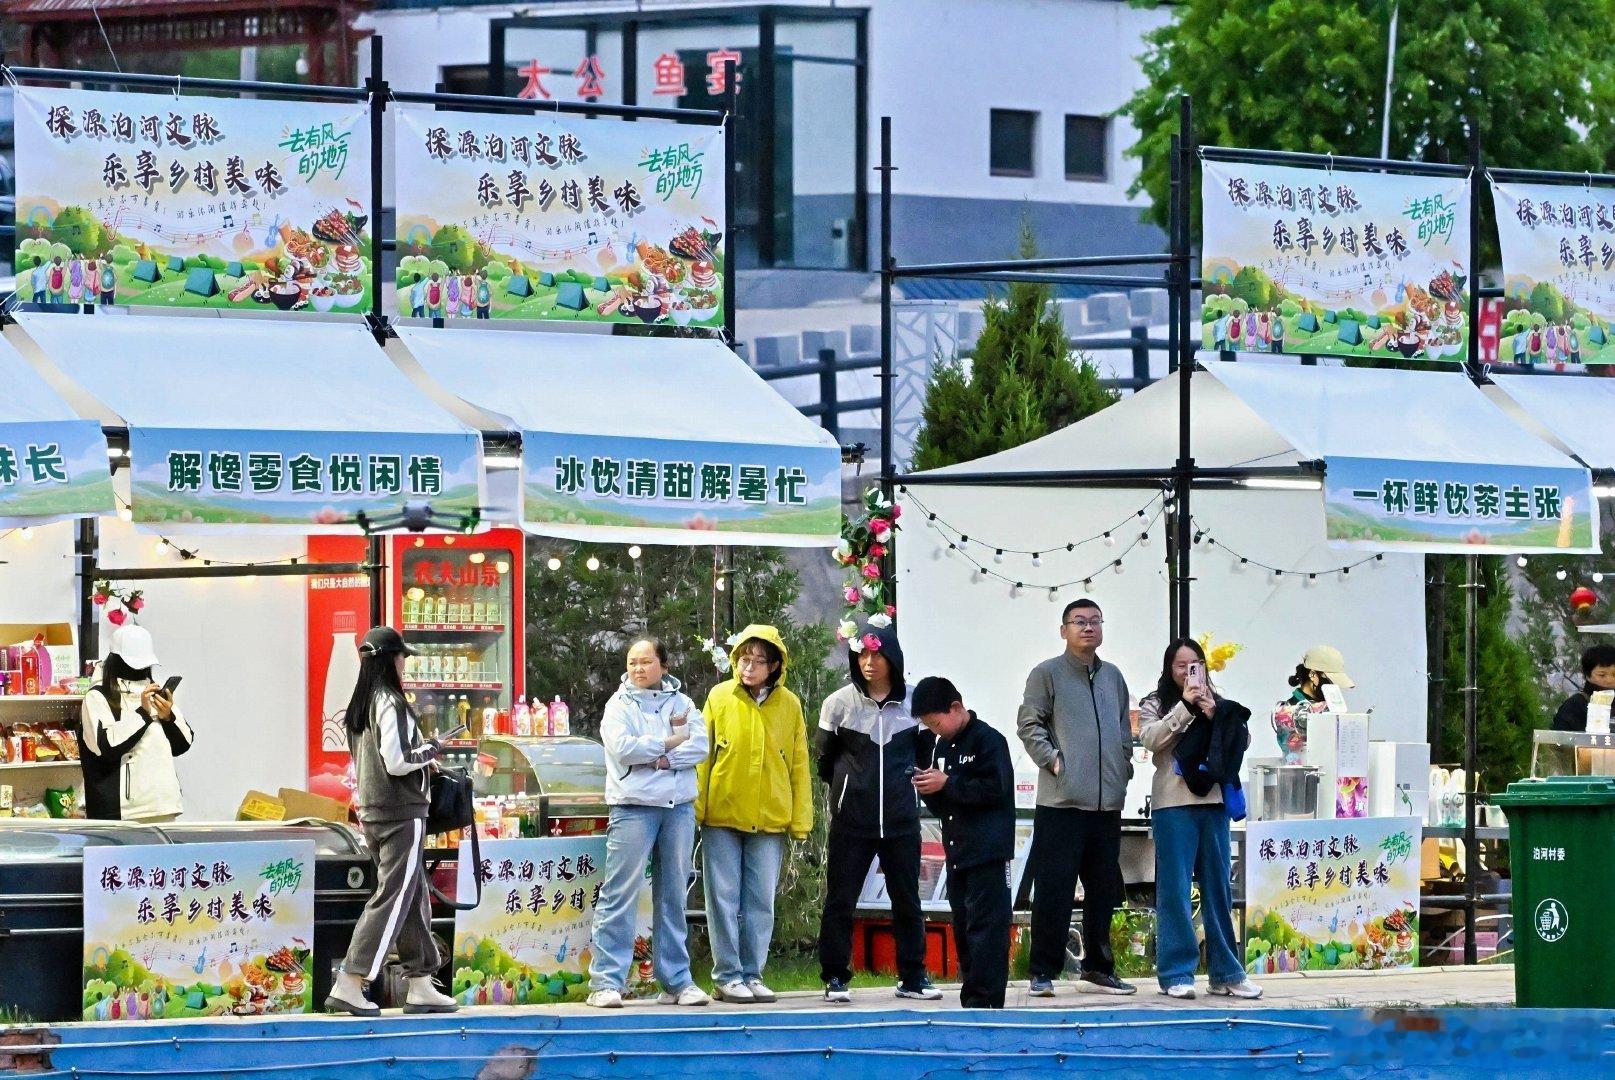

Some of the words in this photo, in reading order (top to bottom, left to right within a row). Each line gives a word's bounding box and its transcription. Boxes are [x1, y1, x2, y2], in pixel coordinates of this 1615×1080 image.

[46, 105, 221, 144] 探源泊河文脉
[426, 127, 584, 165] 探源泊河文脉
[103, 150, 285, 194] 乐享乡村美味
[477, 170, 642, 214] 乐享乡村美味
[1227, 178, 1358, 213] 探源泊河文脉
[1516, 198, 1615, 230] 探源泊河文
[1272, 217, 1408, 260] 乐享乡村美味
[168, 451, 442, 494] 解馋零食悦闲情
[555, 456, 807, 505] 冰饮清甜解暑忙
[1353, 479, 1562, 521] 一杯鲜饮茶主张
[1260, 833, 1360, 860] 探源泊河文脉
[1533, 846, 1565, 861] 泊河村委
[101, 860, 233, 891] 探源泊河文脉
[1286, 861, 1390, 890] 乐享乡村美味
[137, 891, 275, 923] 乐享乡村美味
